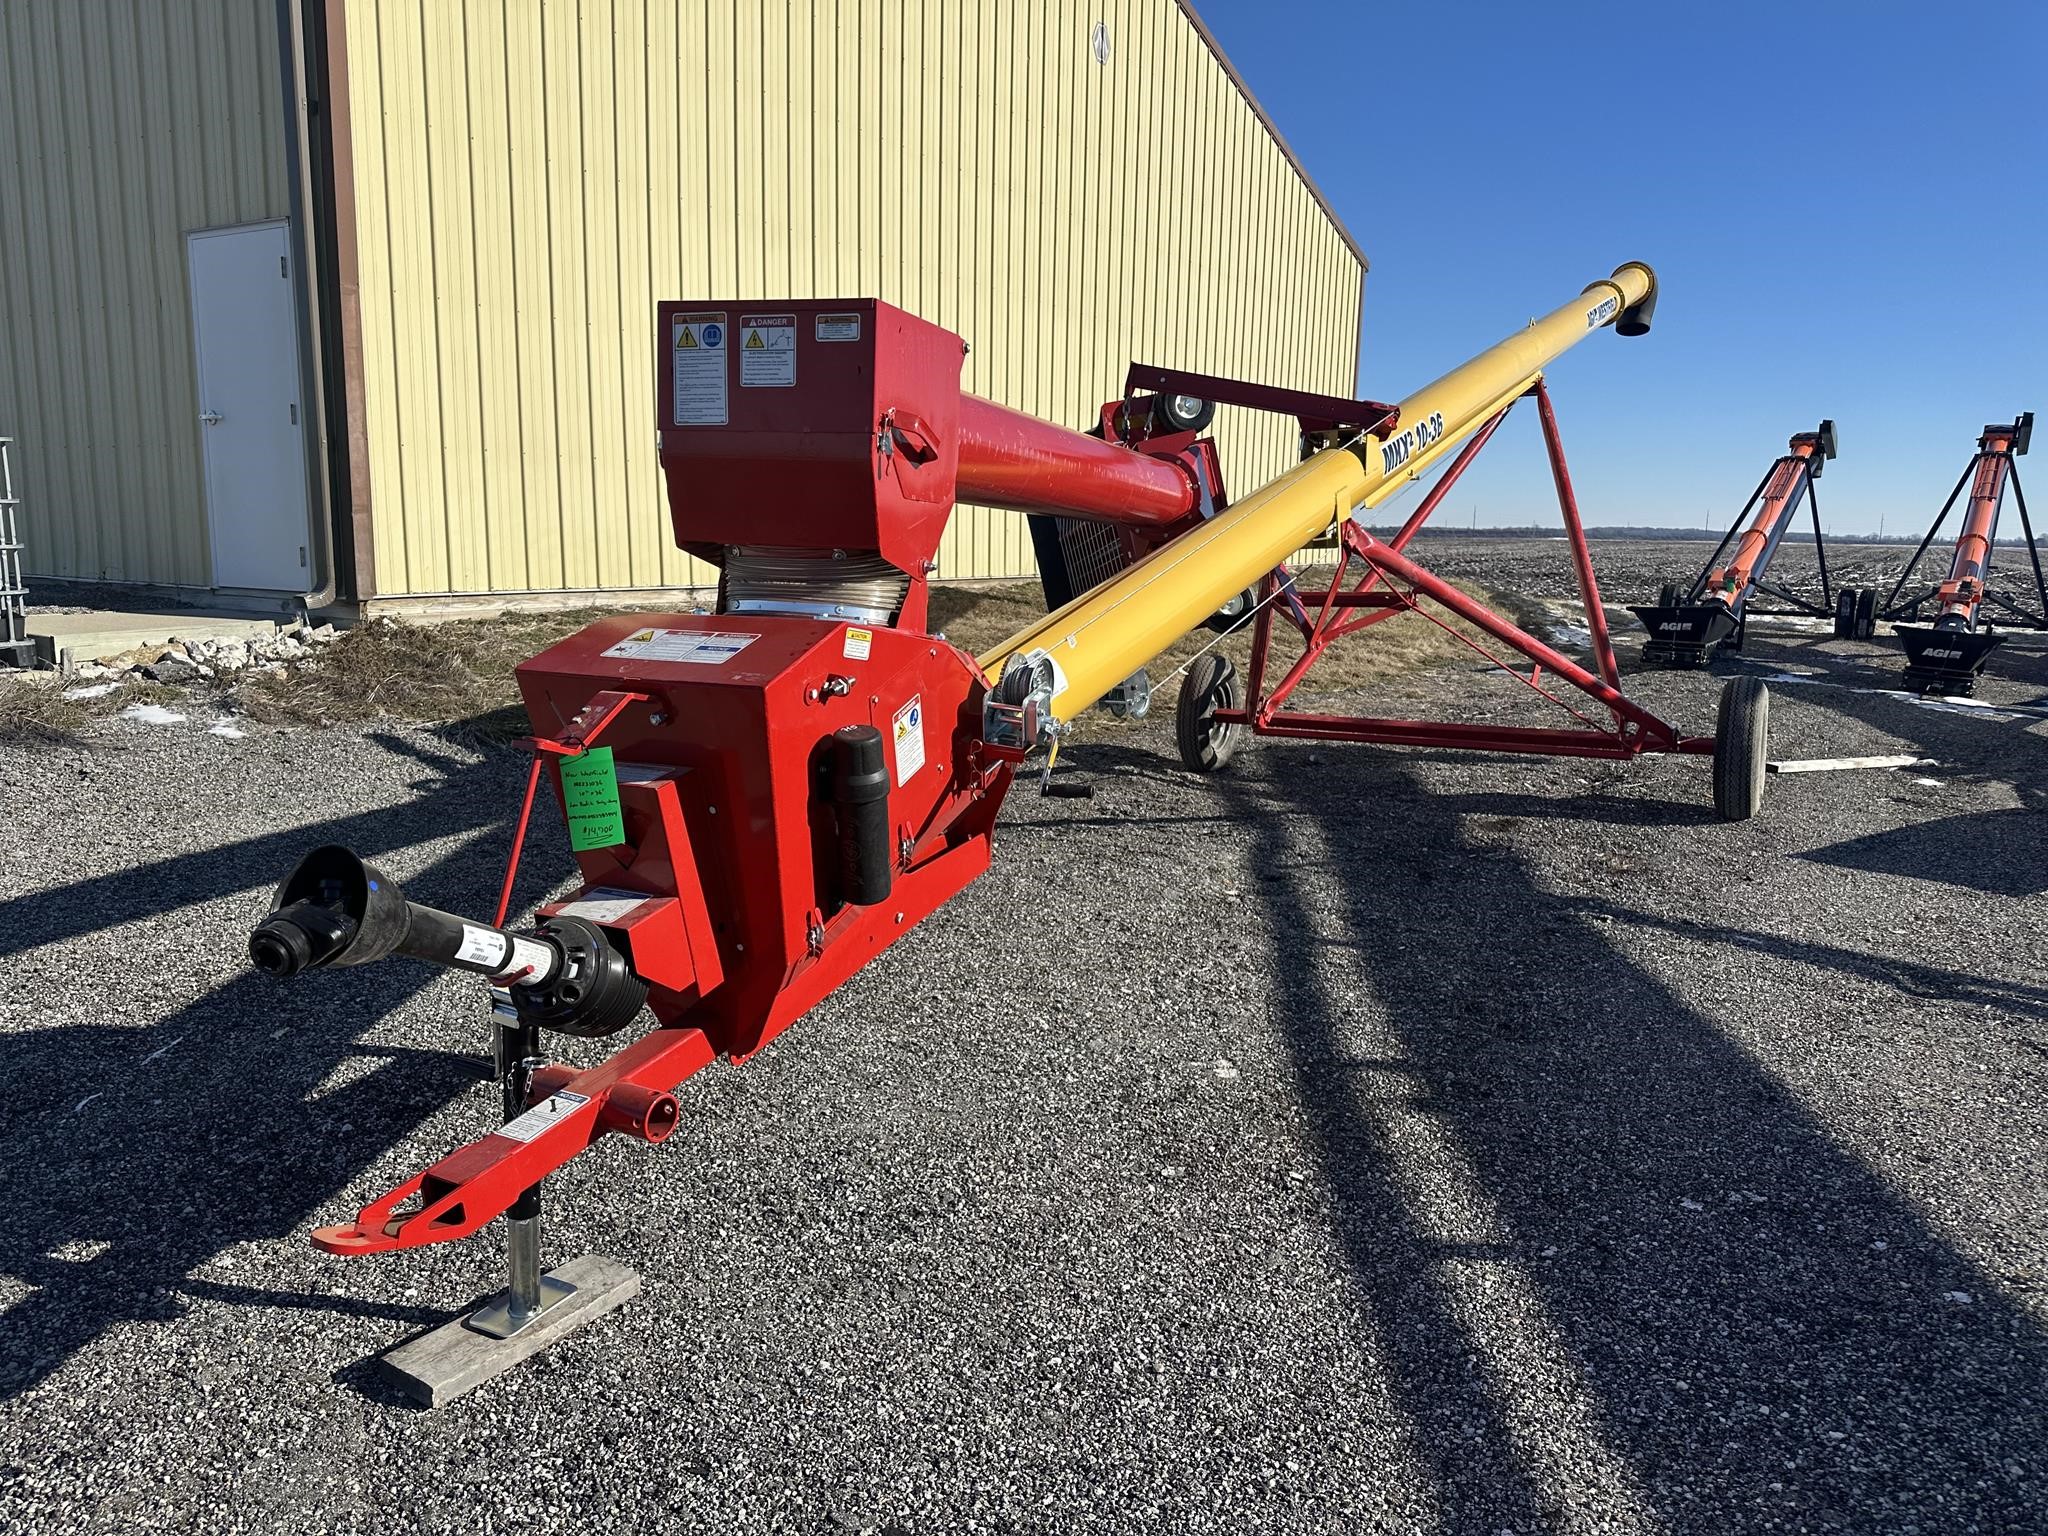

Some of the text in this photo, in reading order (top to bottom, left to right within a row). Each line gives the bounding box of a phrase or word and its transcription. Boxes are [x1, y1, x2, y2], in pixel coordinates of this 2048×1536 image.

[757, 318, 788, 326] DANGER
[1416, 412, 1443, 451] 10-36
[1658, 621, 1682, 631] AGI
[1920, 647, 1951, 659] AGI
[558, 1092, 584, 1103] NOTICE
